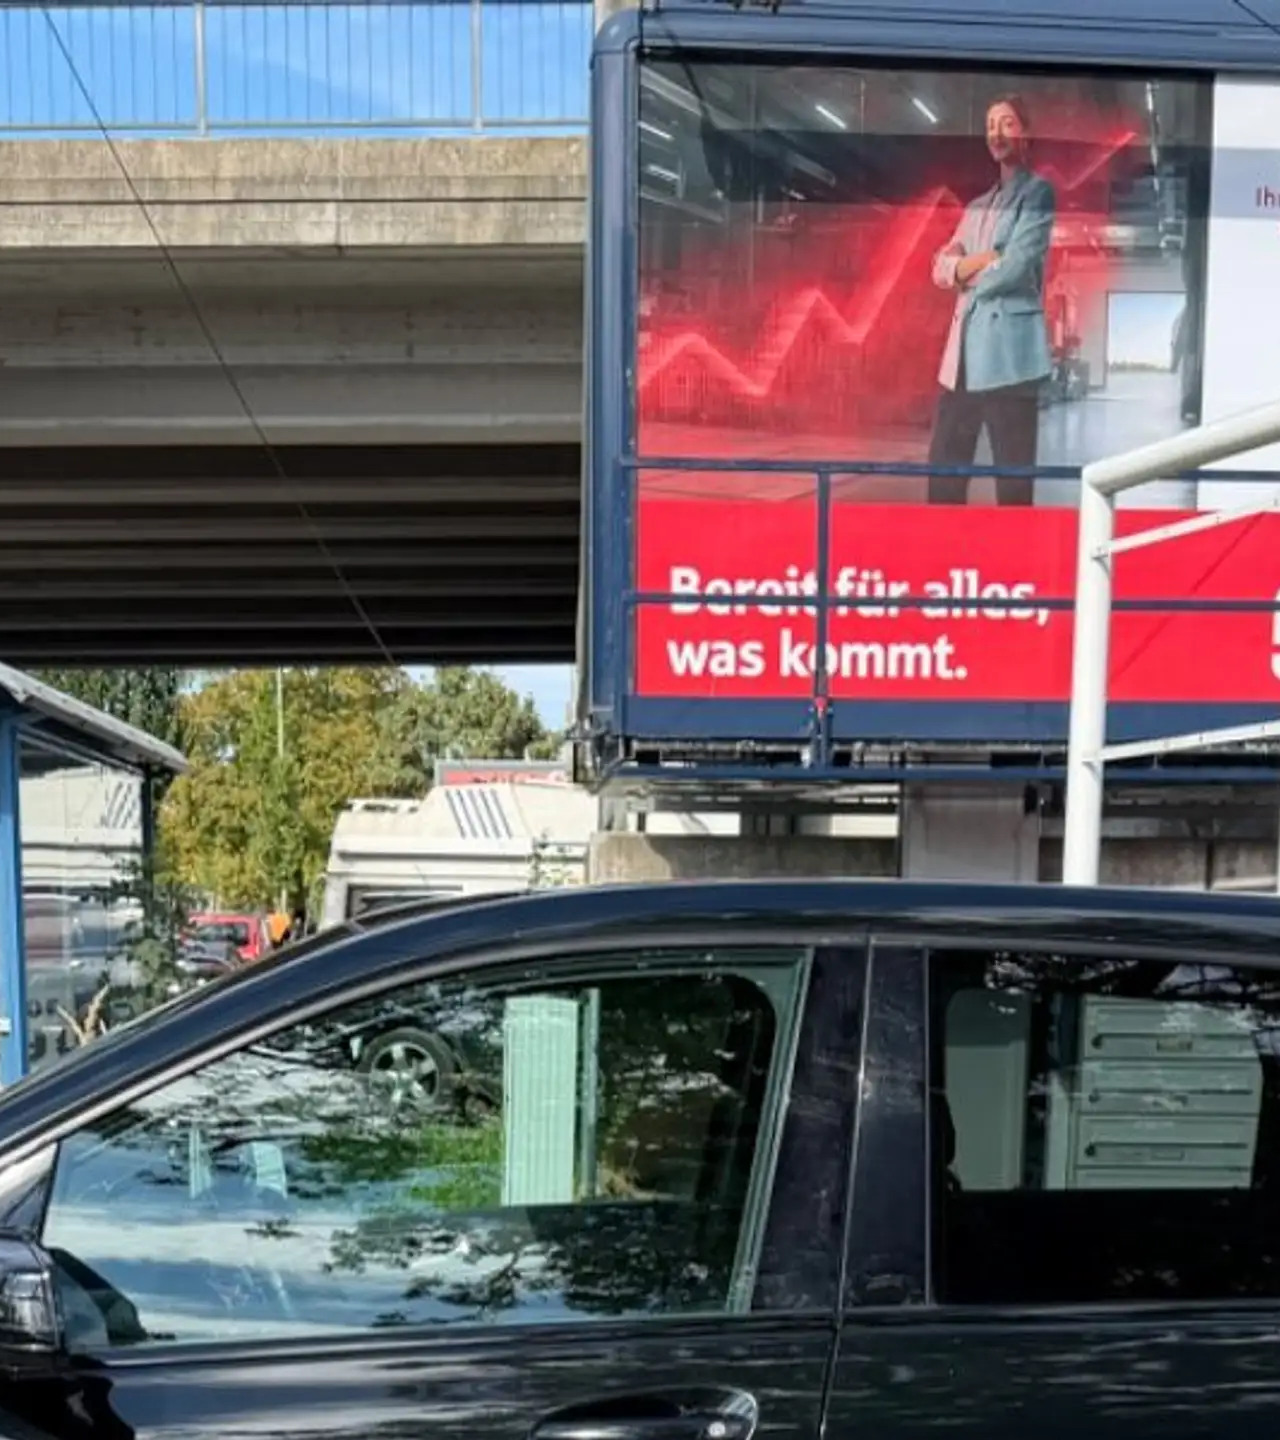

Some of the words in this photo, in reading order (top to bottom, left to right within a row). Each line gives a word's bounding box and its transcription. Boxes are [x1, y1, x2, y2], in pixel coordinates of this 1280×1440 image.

[669, 565, 820, 616] Bereit
[836, 566, 909, 618] für
[924, 569, 1051, 626] alles,
[667, 639, 765, 678] was
[779, 627, 968, 680] kommt.
